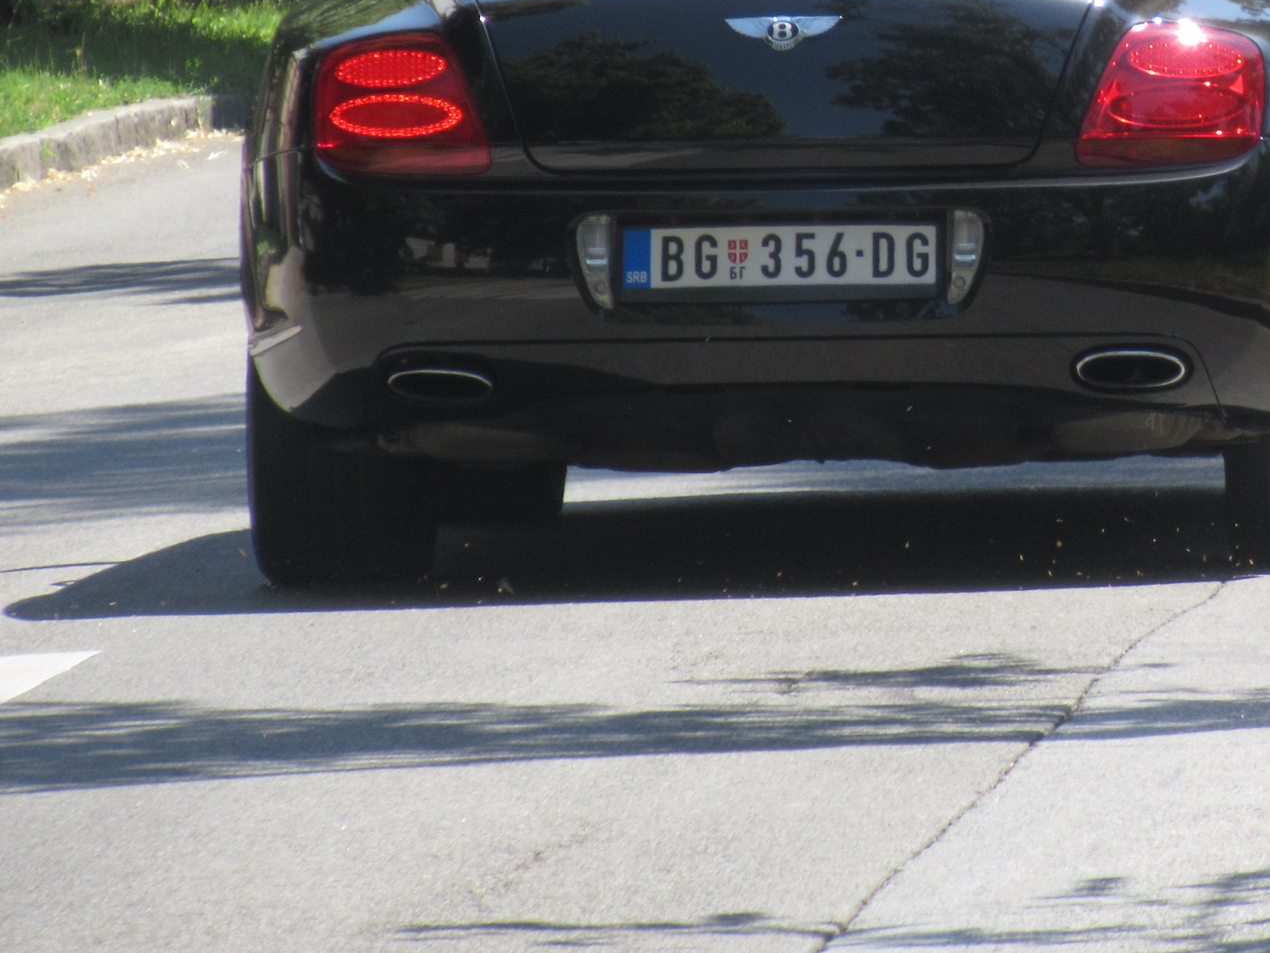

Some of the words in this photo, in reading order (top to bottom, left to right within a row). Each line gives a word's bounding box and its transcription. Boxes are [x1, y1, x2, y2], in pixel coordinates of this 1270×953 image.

[772, 22, 793, 40] B
[660, 233, 719, 283] BG
[626, 271, 648, 284] SRB
